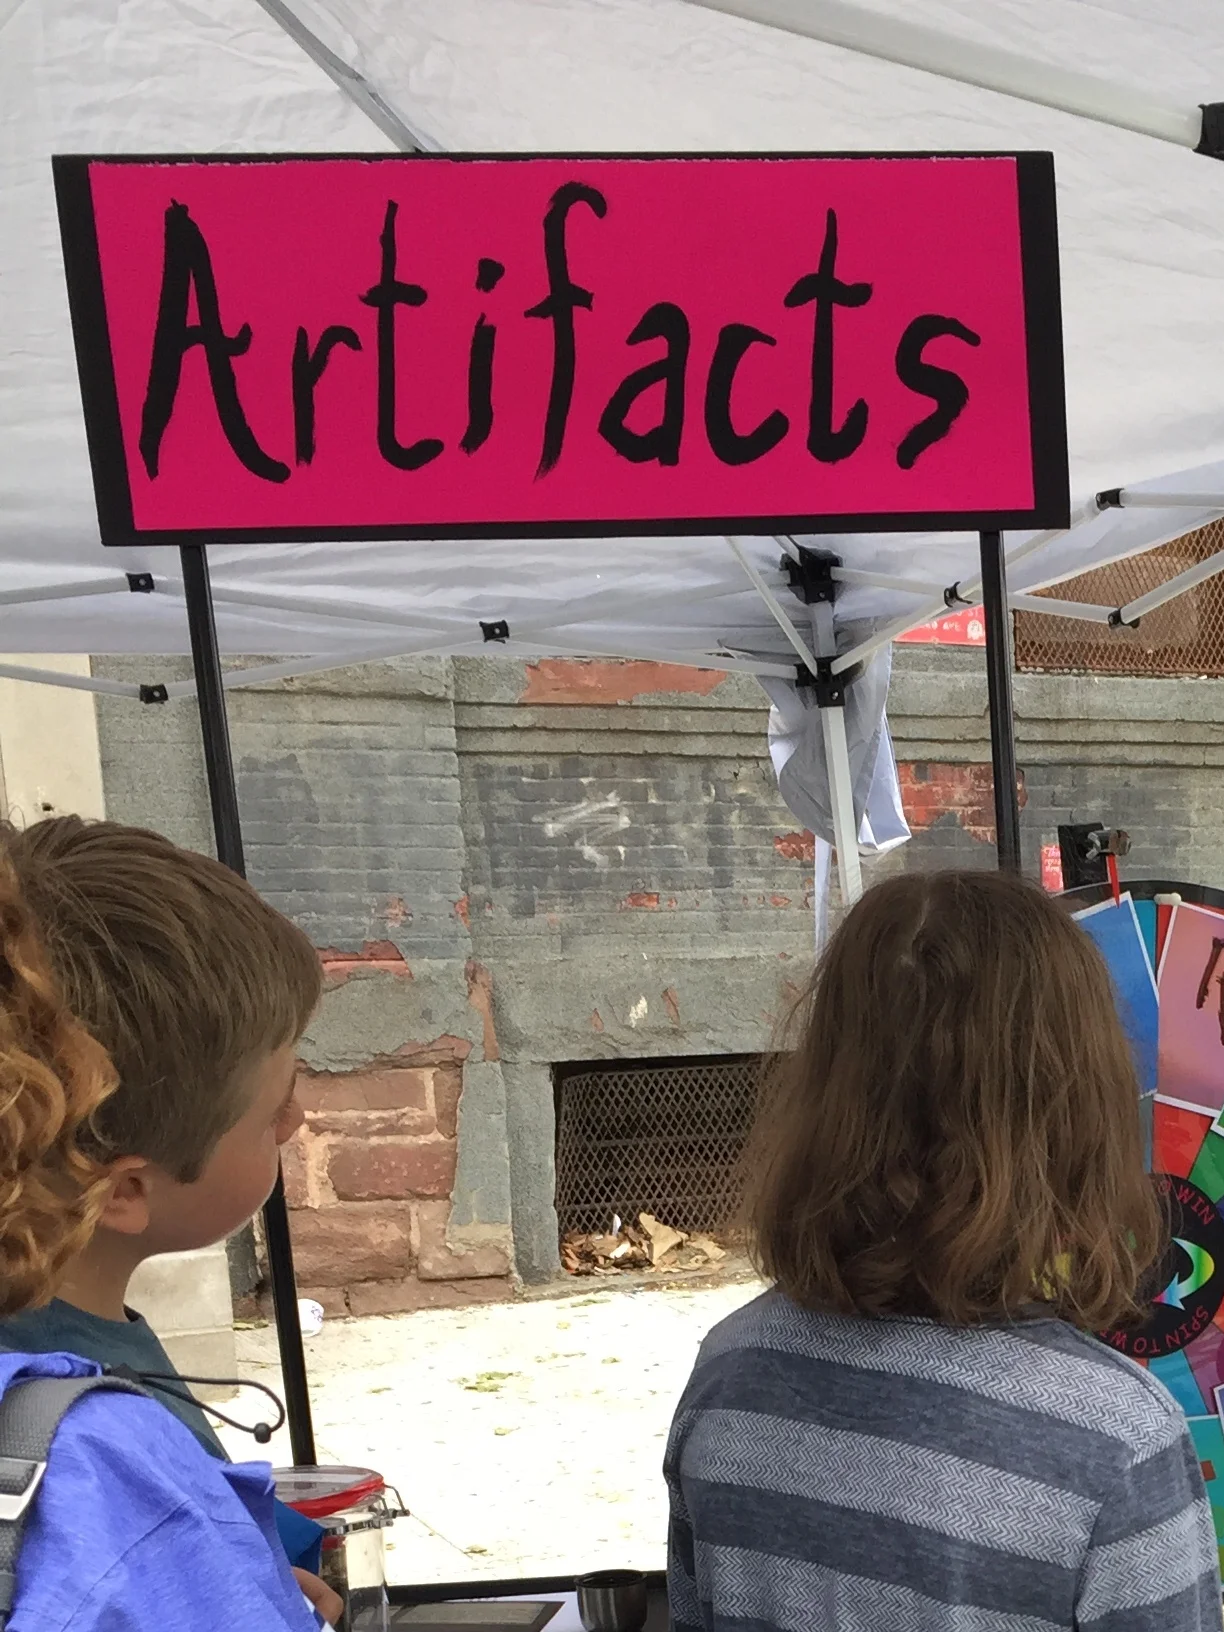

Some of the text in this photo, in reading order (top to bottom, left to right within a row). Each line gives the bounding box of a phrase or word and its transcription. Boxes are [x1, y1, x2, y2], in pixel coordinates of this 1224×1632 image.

[139, 182, 981, 483] Artifacts
[1178, 1184, 1216, 1226] WIN
[1133, 1336, 1163, 1355] TO
[1164, 1305, 1210, 1346] SPIN
